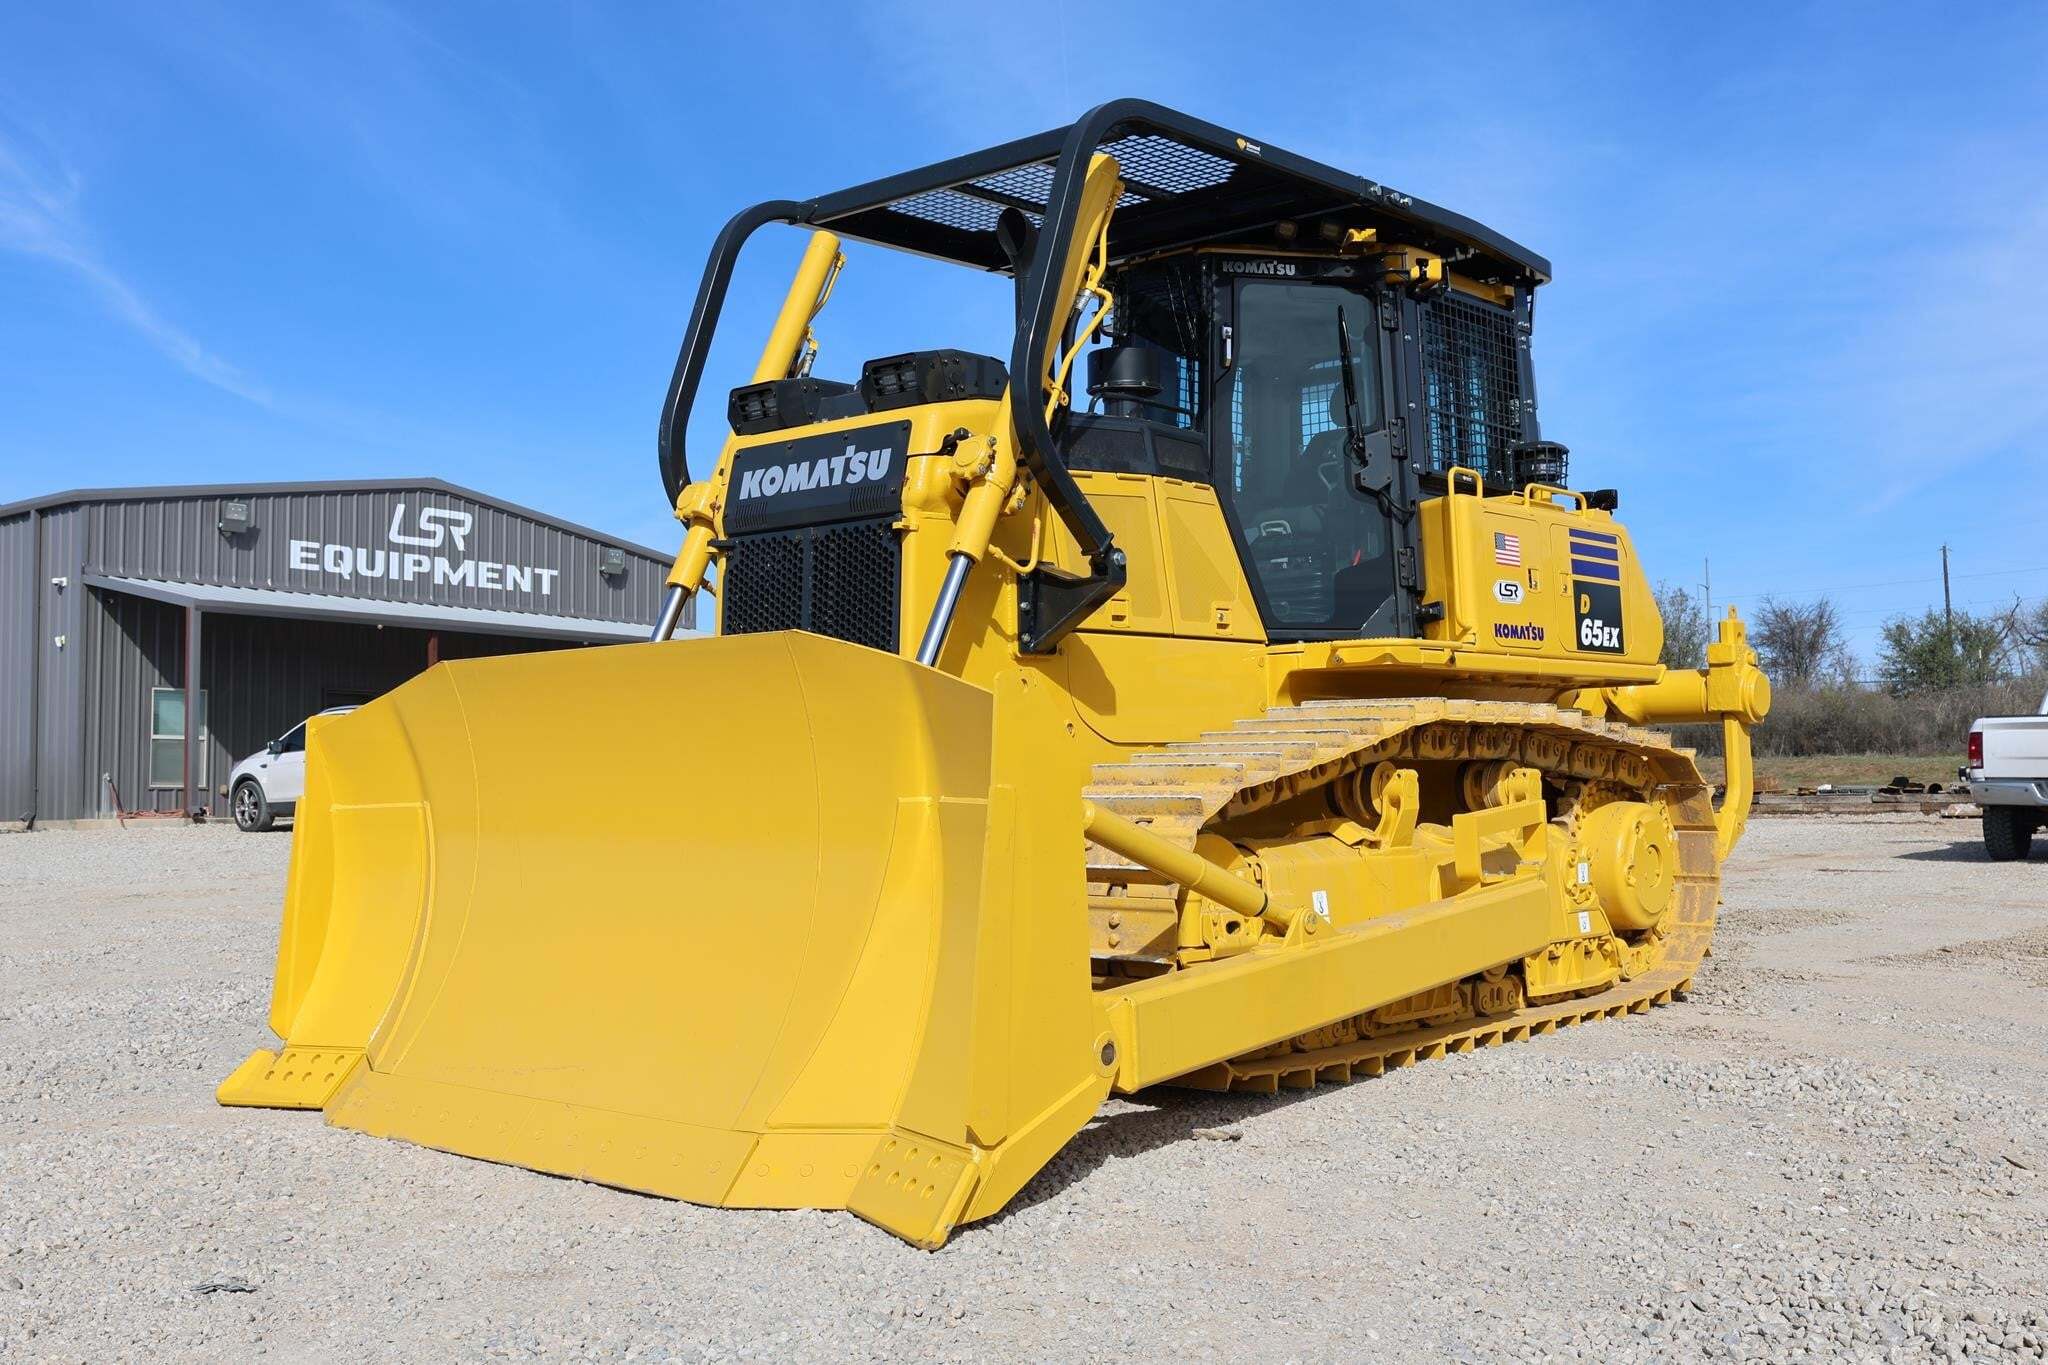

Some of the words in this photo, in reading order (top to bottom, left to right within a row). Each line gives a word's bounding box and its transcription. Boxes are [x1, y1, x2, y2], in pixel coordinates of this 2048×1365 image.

[1223, 260, 1296, 275] KOMATSU
[739, 445, 892, 500] KOMATSU
[389, 503, 473, 551] LSR
[289, 539, 559, 595] EQUIPMENT
[1499, 582, 1518, 598] LSR
[1580, 594, 1591, 614] D
[1494, 622, 1545, 641] KOMATSU
